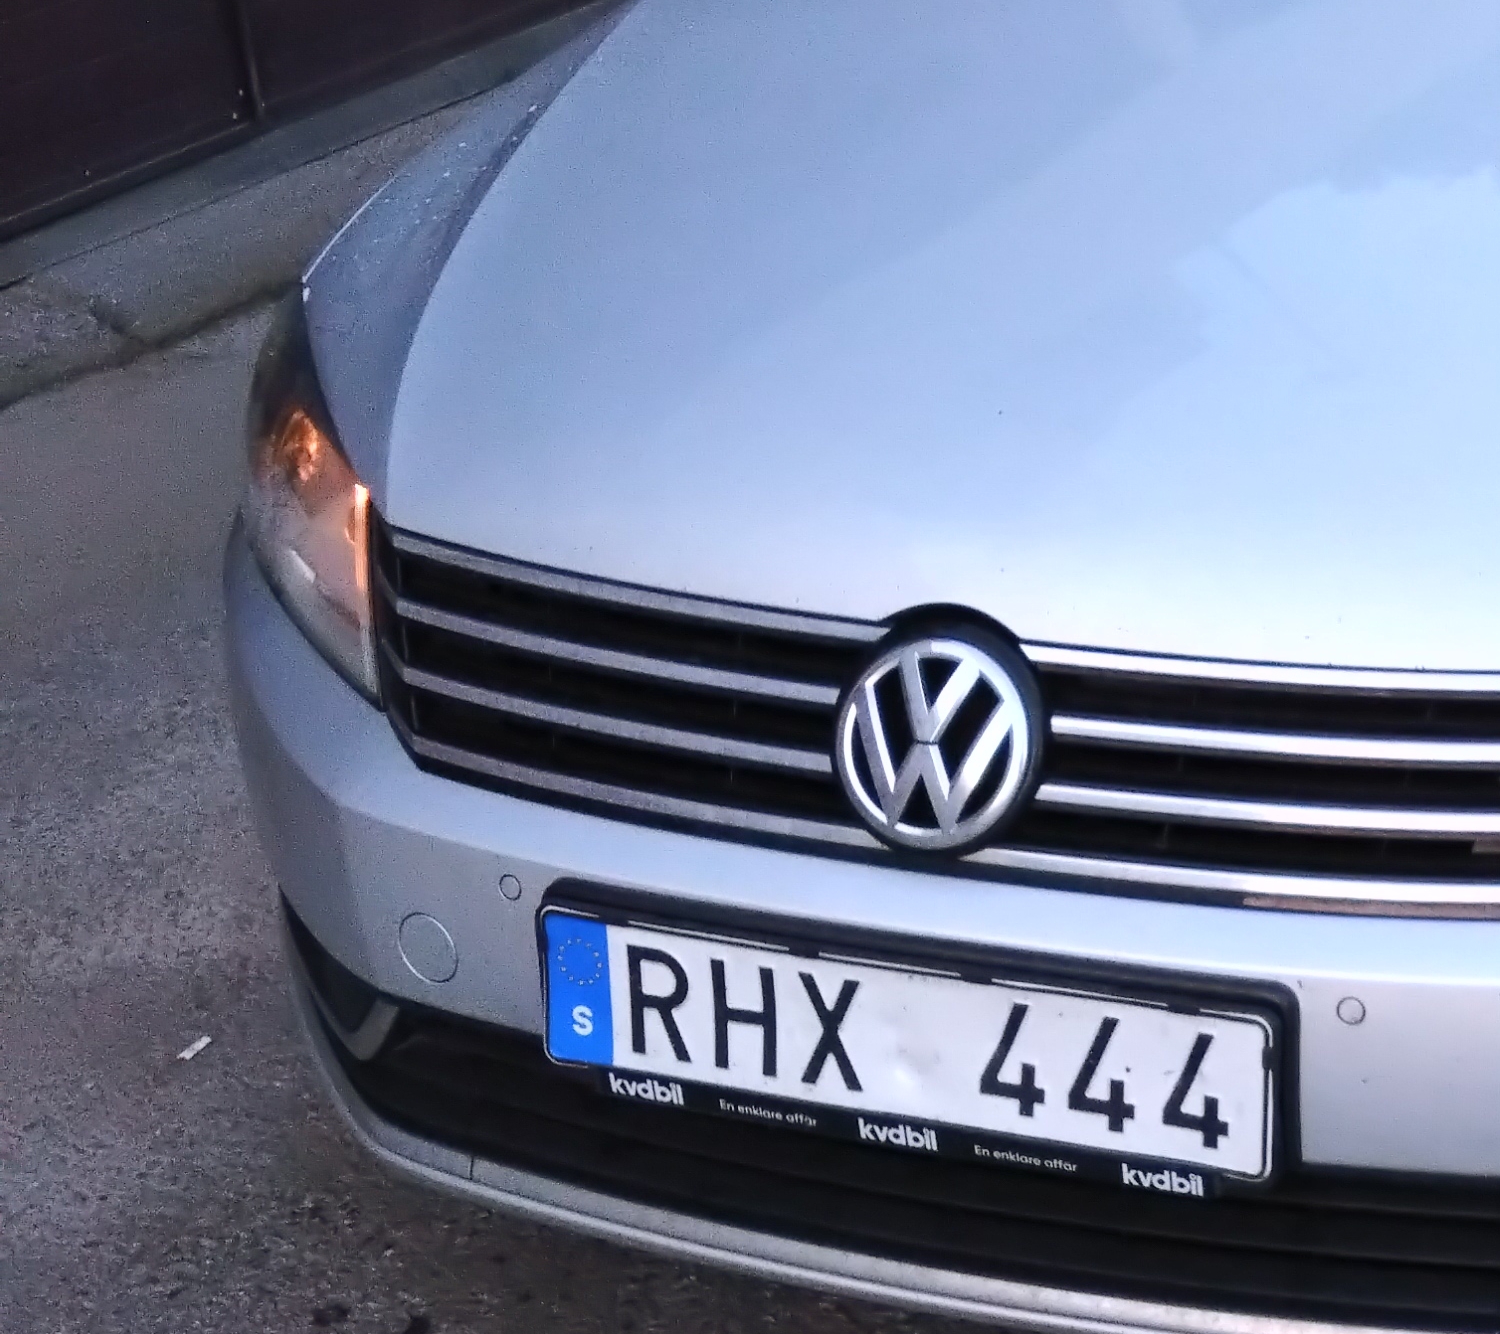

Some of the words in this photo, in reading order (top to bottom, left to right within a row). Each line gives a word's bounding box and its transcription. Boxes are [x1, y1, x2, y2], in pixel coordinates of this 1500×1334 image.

[572, 1005, 593, 1036] S
[626, 944, 862, 1092] RHX
[980, 1003, 1229, 1149] 444
[609, 1072, 684, 1105] kvdbil
[719, 1098, 735, 1111] En
[738, 1104, 783, 1121] enklare
[857, 1117, 938, 1151] kvdbil
[974, 1144, 990, 1157] En
[993, 1149, 1042, 1166] enklare
[1121, 1162, 1204, 1197] kvdbil
